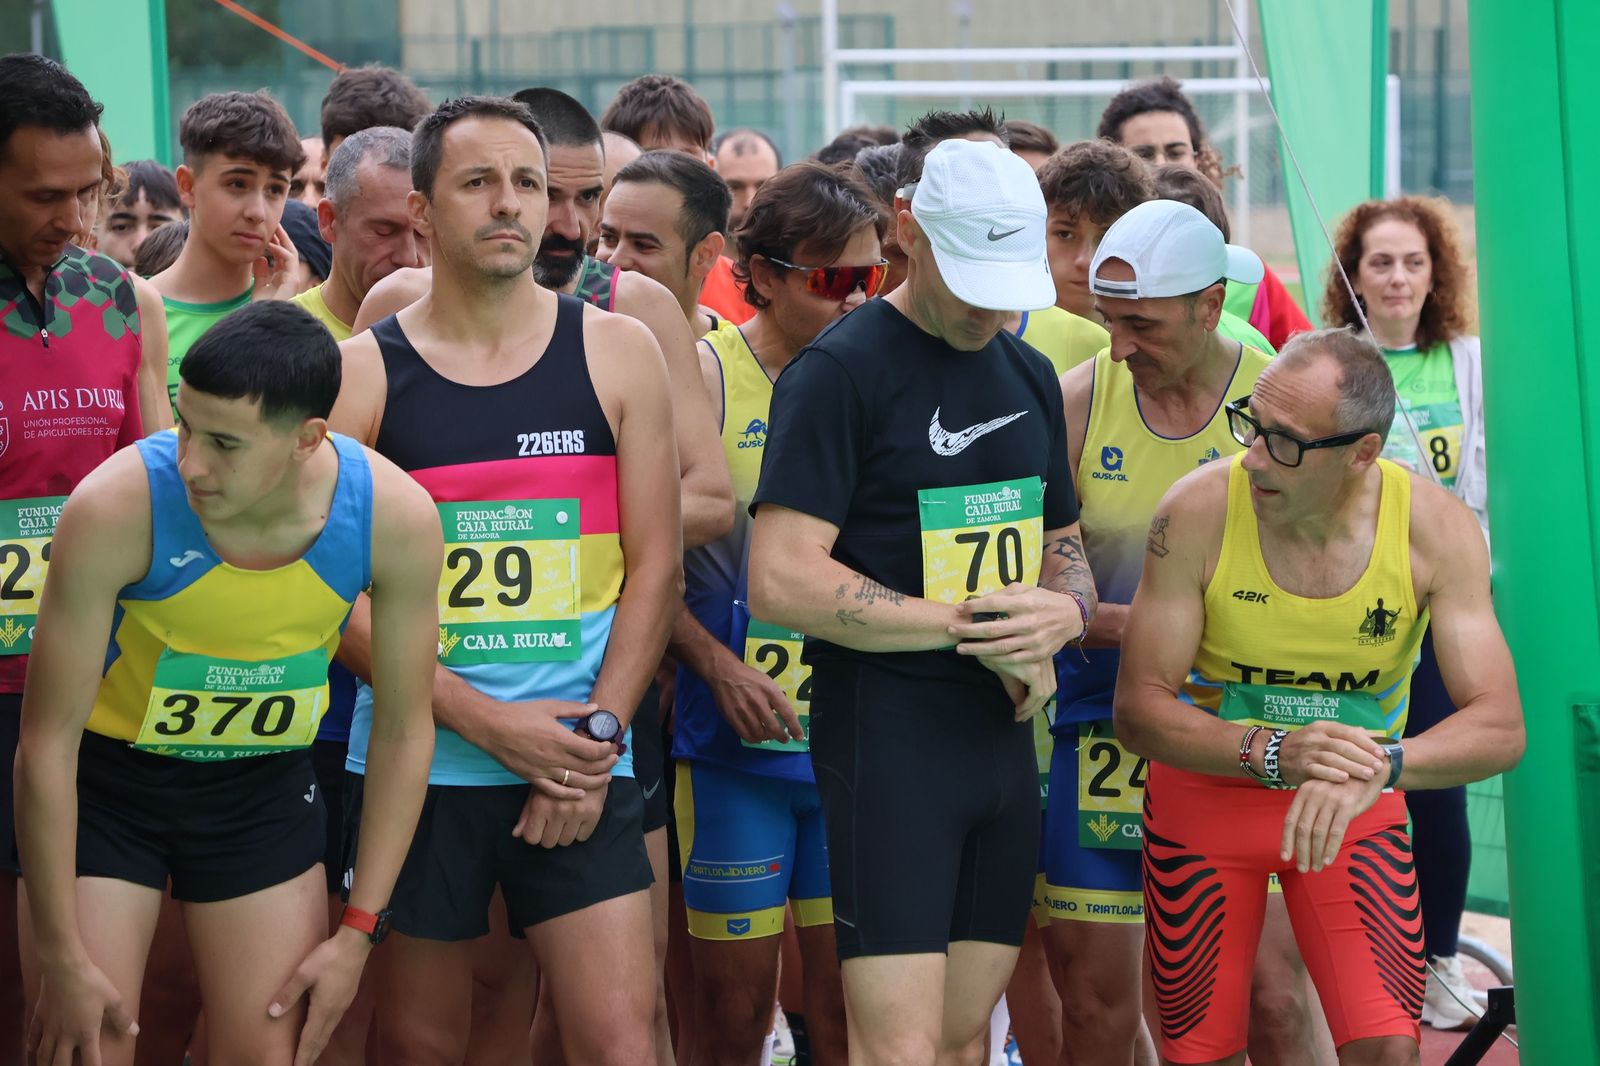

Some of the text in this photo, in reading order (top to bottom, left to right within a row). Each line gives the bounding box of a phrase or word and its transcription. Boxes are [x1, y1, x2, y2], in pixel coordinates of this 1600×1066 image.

[22, 389, 69, 411] APIS
[53, 416, 108, 426] PROFESIONAL
[24, 430, 36, 439] DE
[37, 428, 92, 437] APICULTORES
[93, 427, 104, 436] DE
[517, 430, 585, 456] 226ERS
[965, 500, 1022, 516] CAJA RURAL
[19, 516, 48, 529] CAJA
[456, 520, 533, 532] CAJA RURAL
[977, 515, 1001, 523] ZAMORA
[955, 527, 1023, 592] 70
[446, 546, 533, 608] 29
[1232, 590, 1270, 604] 42K
[463, 634, 508, 650] CAJA
[205, 675, 283, 686] CAJA RURAL
[1231, 661, 1380, 691] TEAM
[154, 694, 296, 736] 370
[1263, 704, 1340, 719] CAJA RURAL
[1275, 716, 1305, 724] ZAMORA
